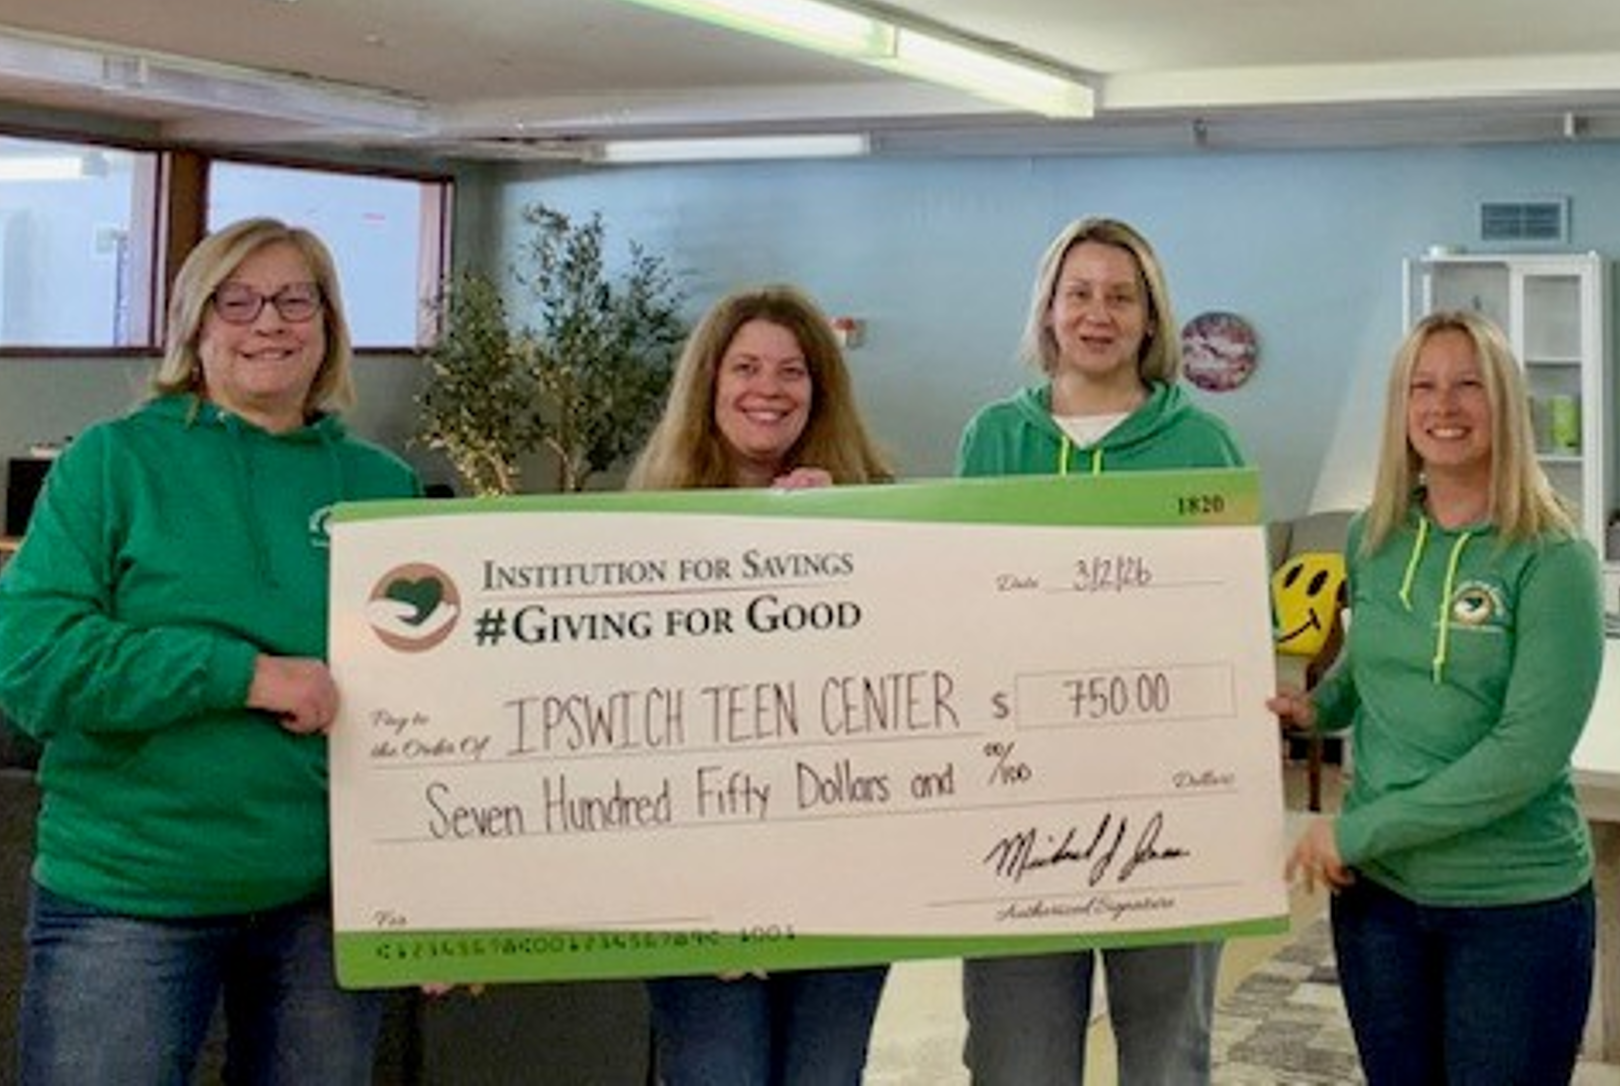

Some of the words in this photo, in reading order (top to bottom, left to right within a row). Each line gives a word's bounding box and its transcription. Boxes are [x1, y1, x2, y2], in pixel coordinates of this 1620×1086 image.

[1177, 495, 1225, 516] 1820
[482, 560, 667, 591] INSTITUTION
[679, 557, 731, 582] FOR
[742, 549, 855, 579] SAVINGS
[1073, 556, 1152, 594] 3/2/26
[475, 604, 653, 647] #GIVING
[665, 607, 734, 637] FOR
[745, 594, 862, 634] GOOD
[502, 686, 686, 756] IPSWICH
[701, 679, 799, 744] TEEN
[821, 670, 960, 737] CENTER
[425, 782, 526, 839] Seven
[542, 773, 672, 834] Hundred
[696, 764, 771, 821] Fifty
[795, 757, 892, 810] Dollars
[909, 762, 957, 799] and
